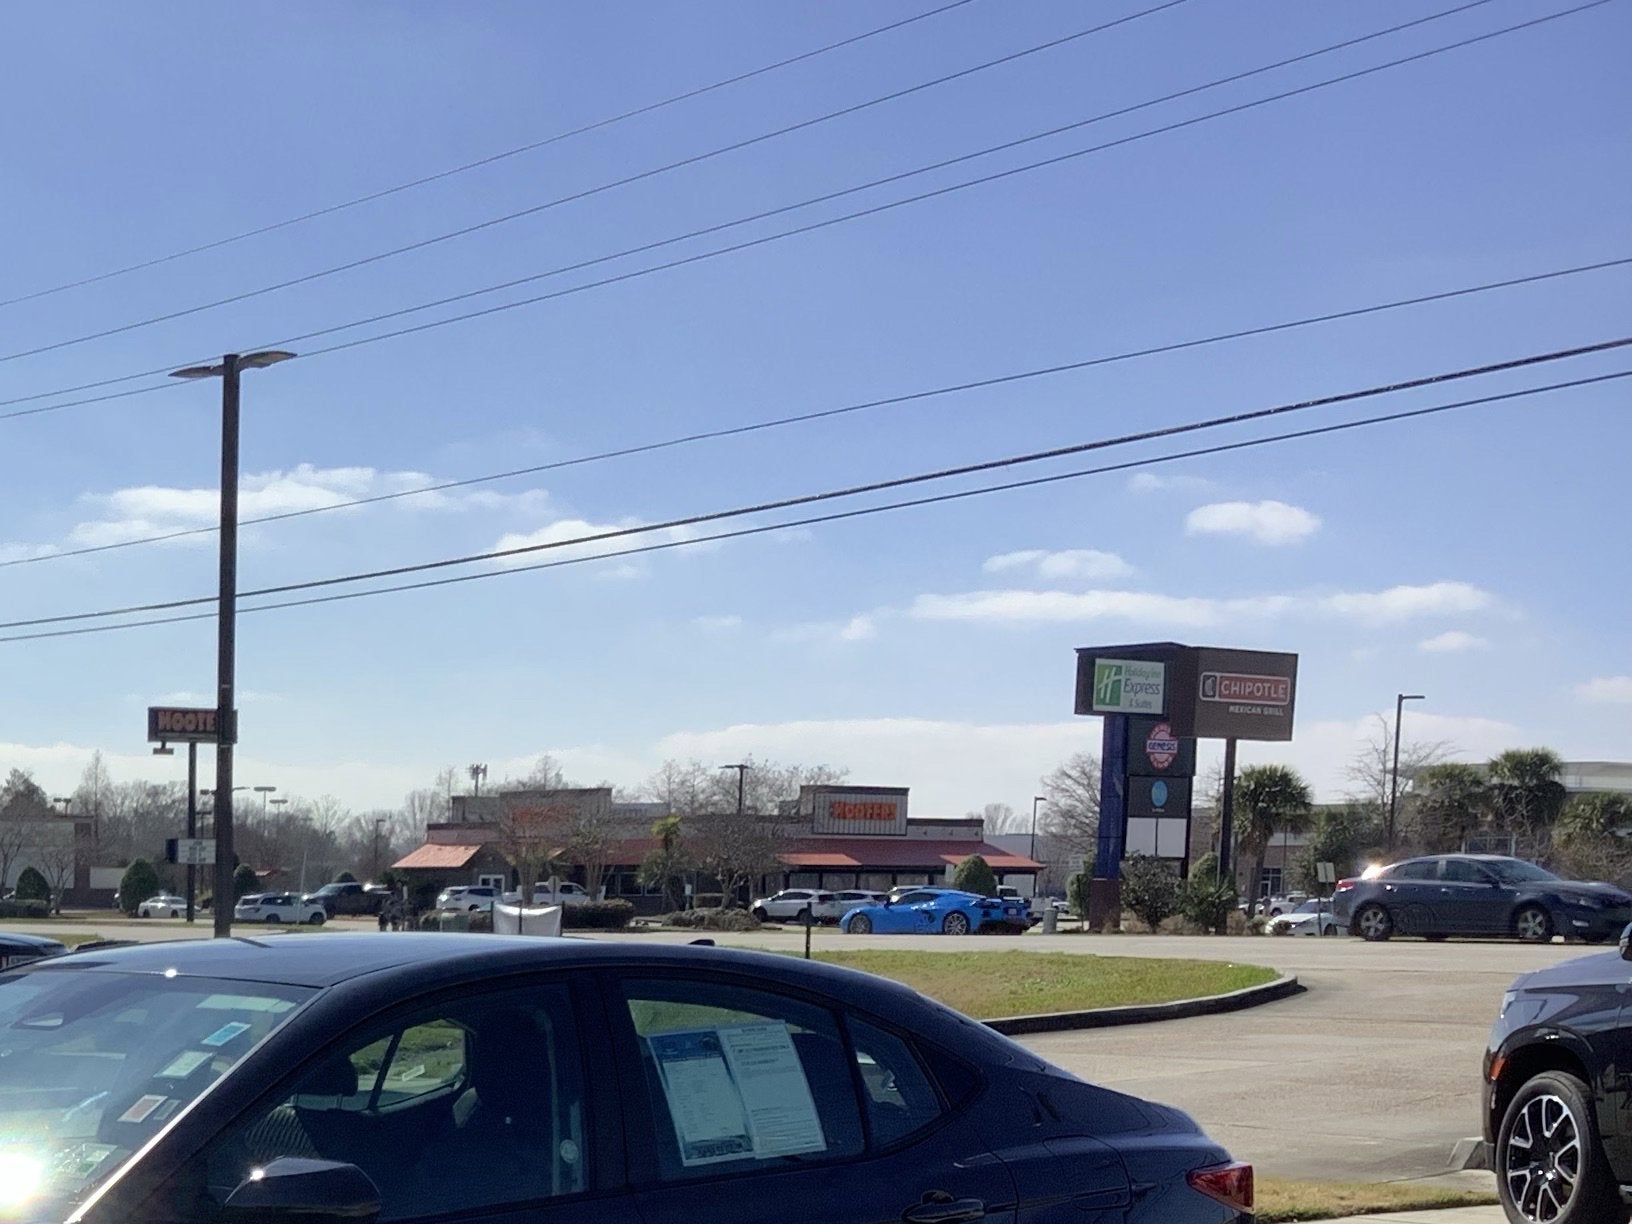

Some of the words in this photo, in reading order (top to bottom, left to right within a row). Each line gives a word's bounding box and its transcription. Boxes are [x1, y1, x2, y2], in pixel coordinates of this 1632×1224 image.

[1123, 678, 1161, 697] Express
[1221, 681, 1286, 699] CHIPOTLE
[1228, 705, 1261, 714] MEXICAN
[1263, 707, 1284, 716] GRILL
[157, 711, 217, 731] HOOTE
